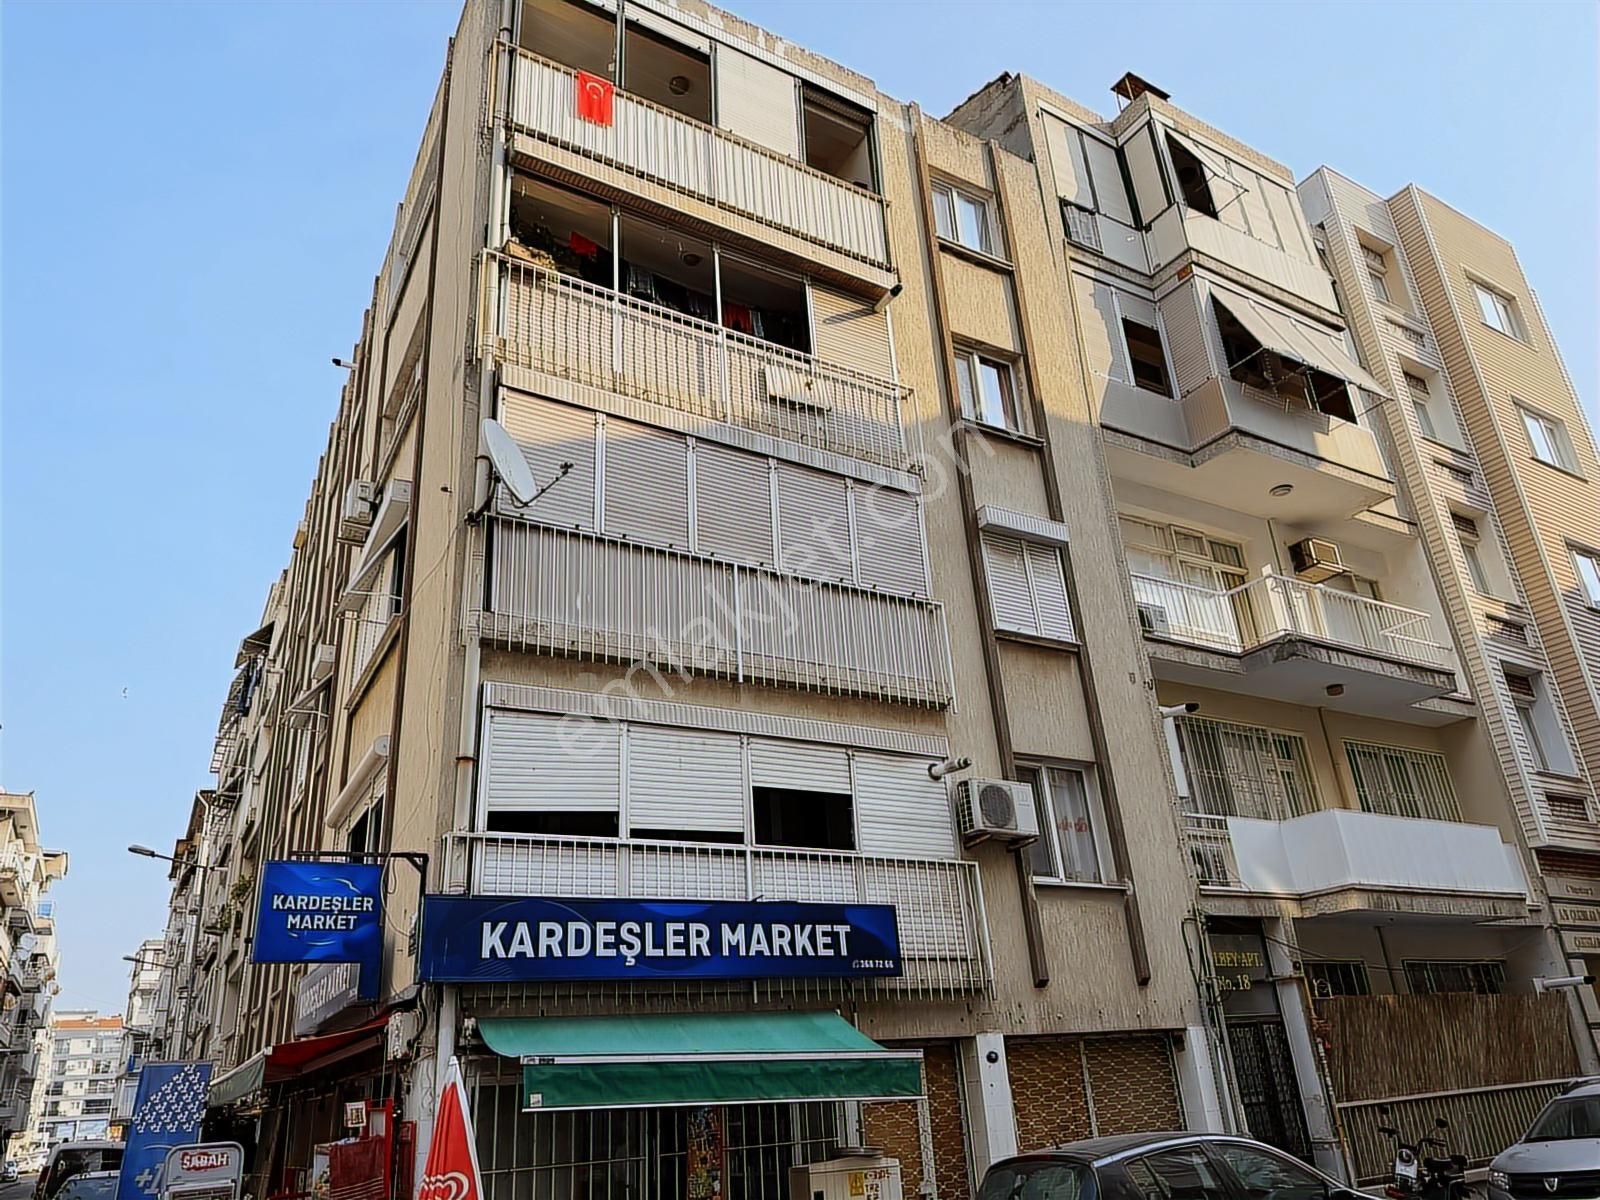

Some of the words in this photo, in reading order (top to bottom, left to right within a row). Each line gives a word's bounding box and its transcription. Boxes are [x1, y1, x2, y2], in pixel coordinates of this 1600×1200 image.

[272, 894, 374, 914] KARDEŞLER
[286, 914, 358, 930] MARKET
[480, 920, 712, 966] KARDEŞLER
[720, 922, 851, 957] MARKET
[182, 1153, 228, 1169] SABAH
